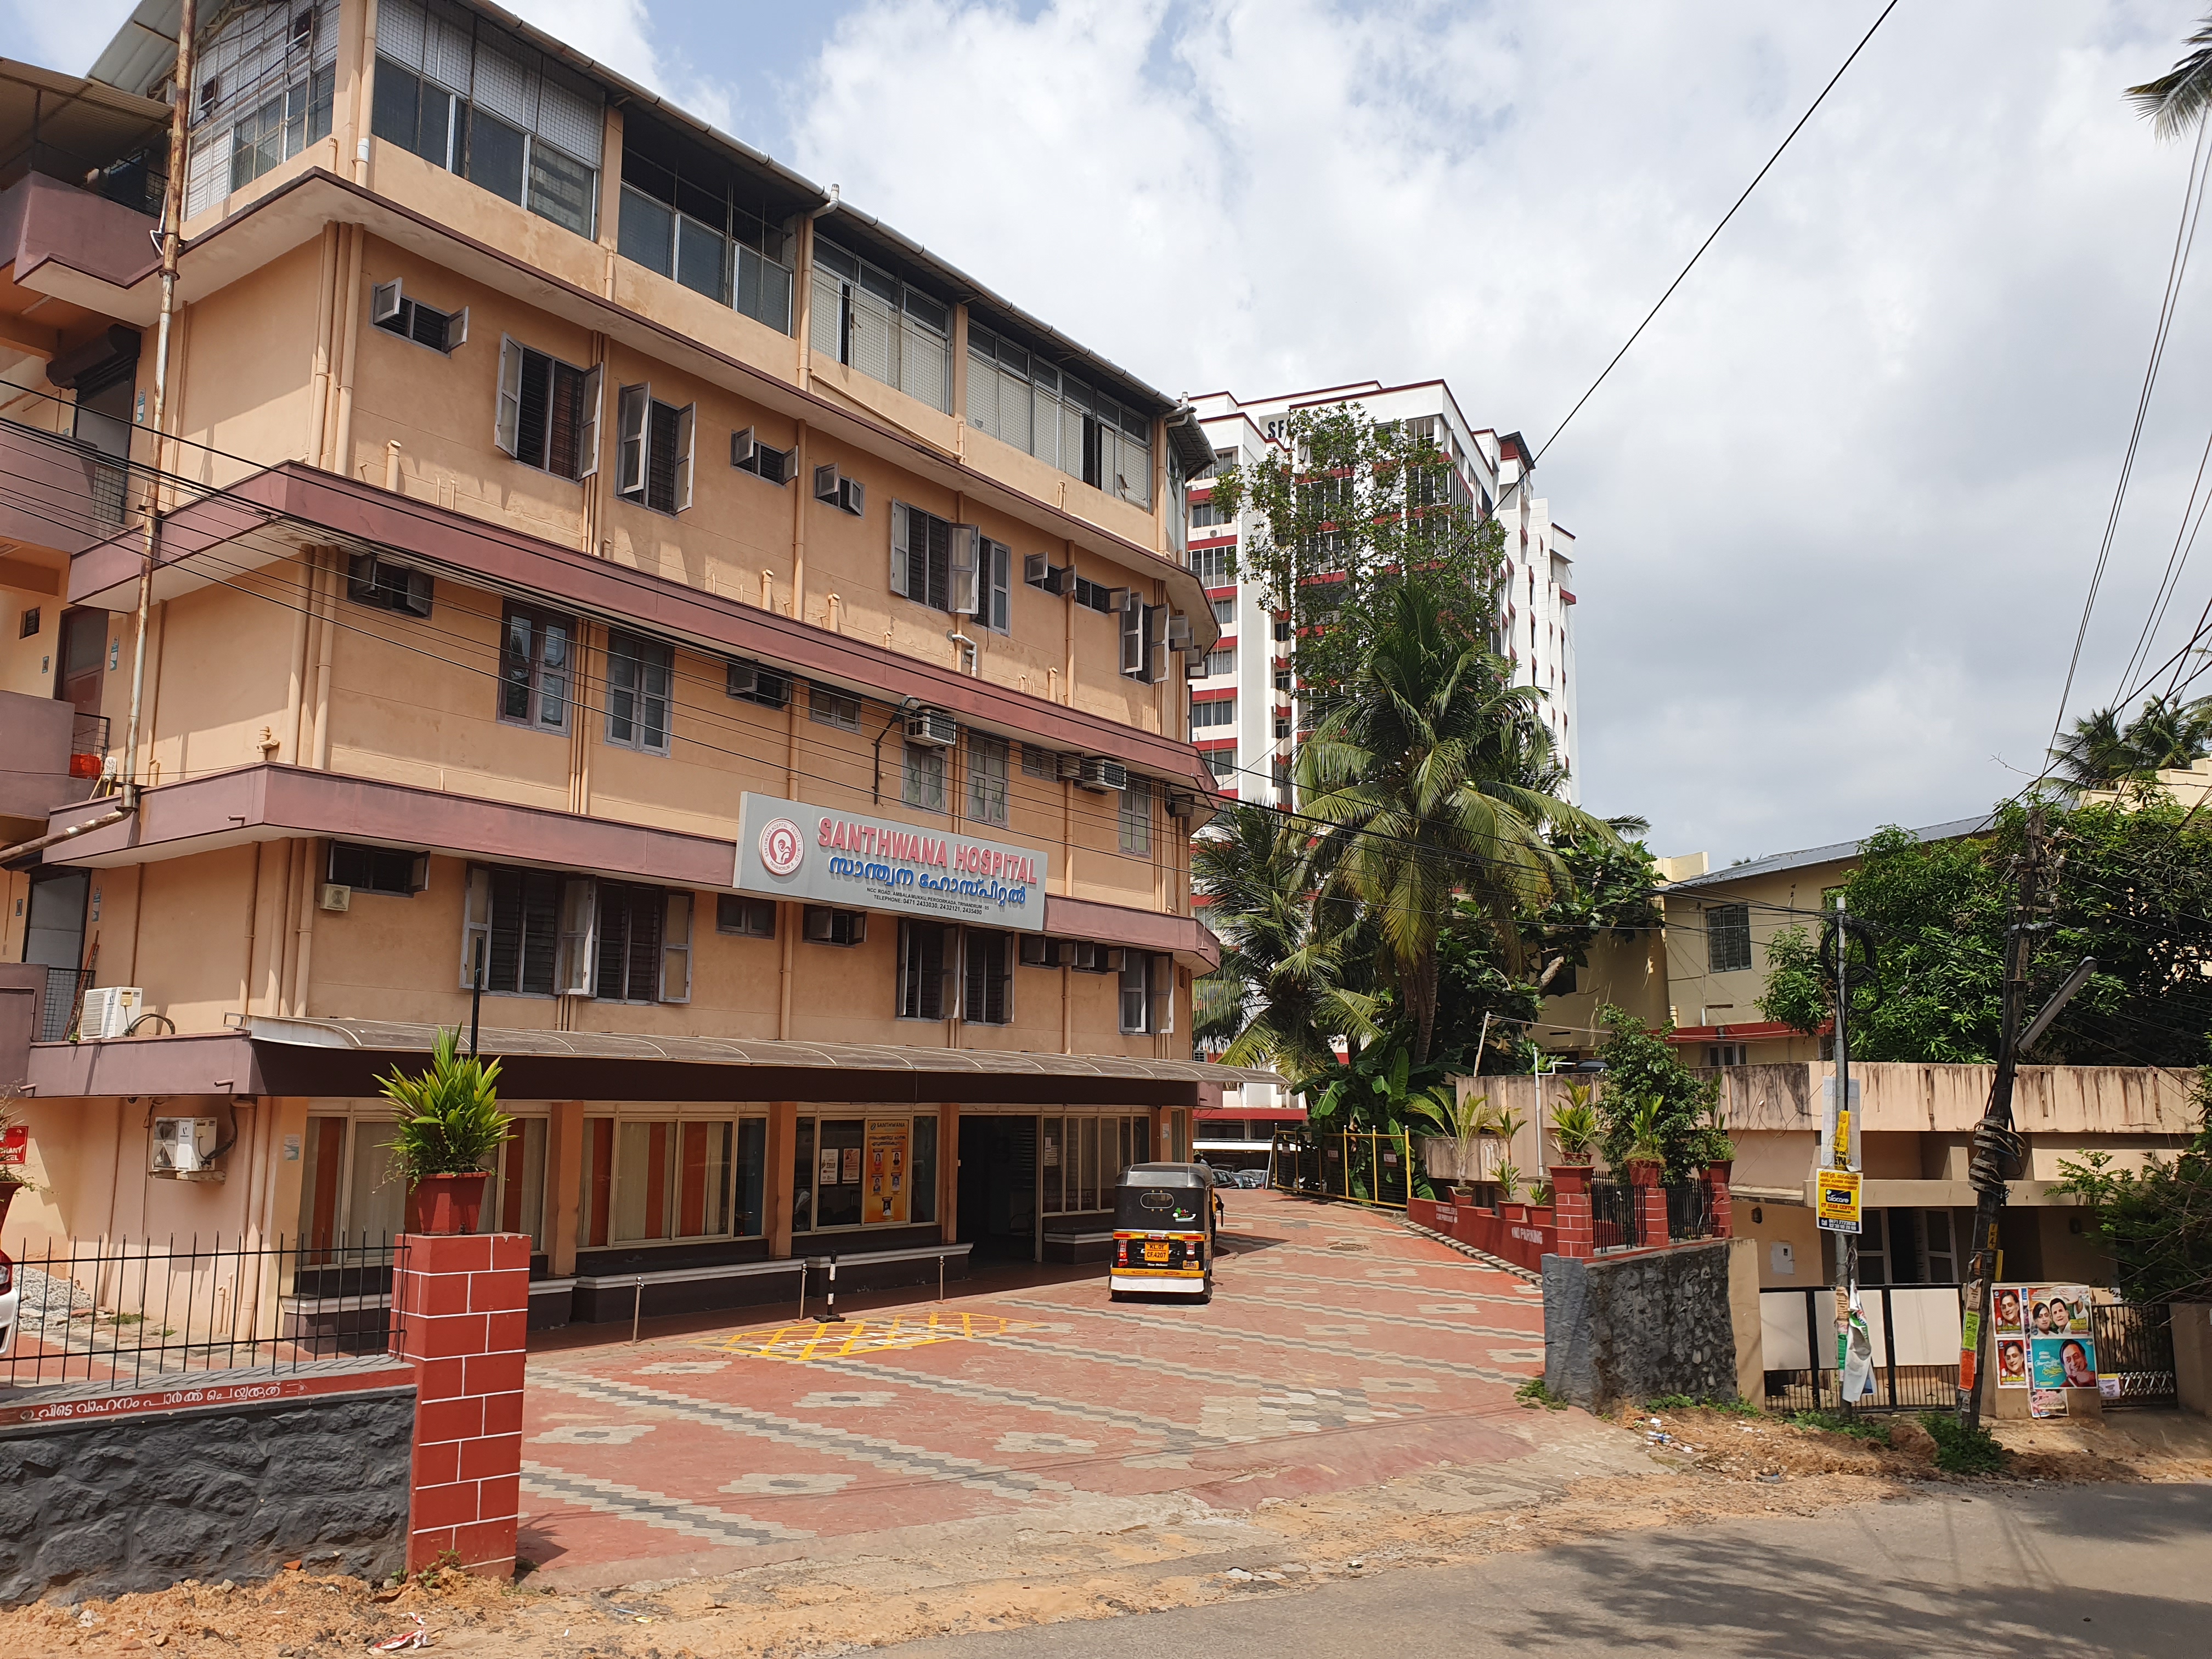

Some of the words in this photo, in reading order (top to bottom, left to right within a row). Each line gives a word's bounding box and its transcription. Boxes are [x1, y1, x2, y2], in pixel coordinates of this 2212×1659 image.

[764, 830, 772, 857] SANTHWANA
[791, 827, 800, 843] PRIVATE
[817, 817, 947, 867] SANTHWANA
[953, 844, 1037, 884] HOSPITAL
[828, 856, 915, 887] സാന്ത്വന
[918, 872, 1025, 906] ഹോസ്പിറ്റൽ
[940, 904, 961, 912] 2432121,
[1520, 1228, 1543, 1244] PARKING
[76, 1397, 140, 1414] വാഹനം
